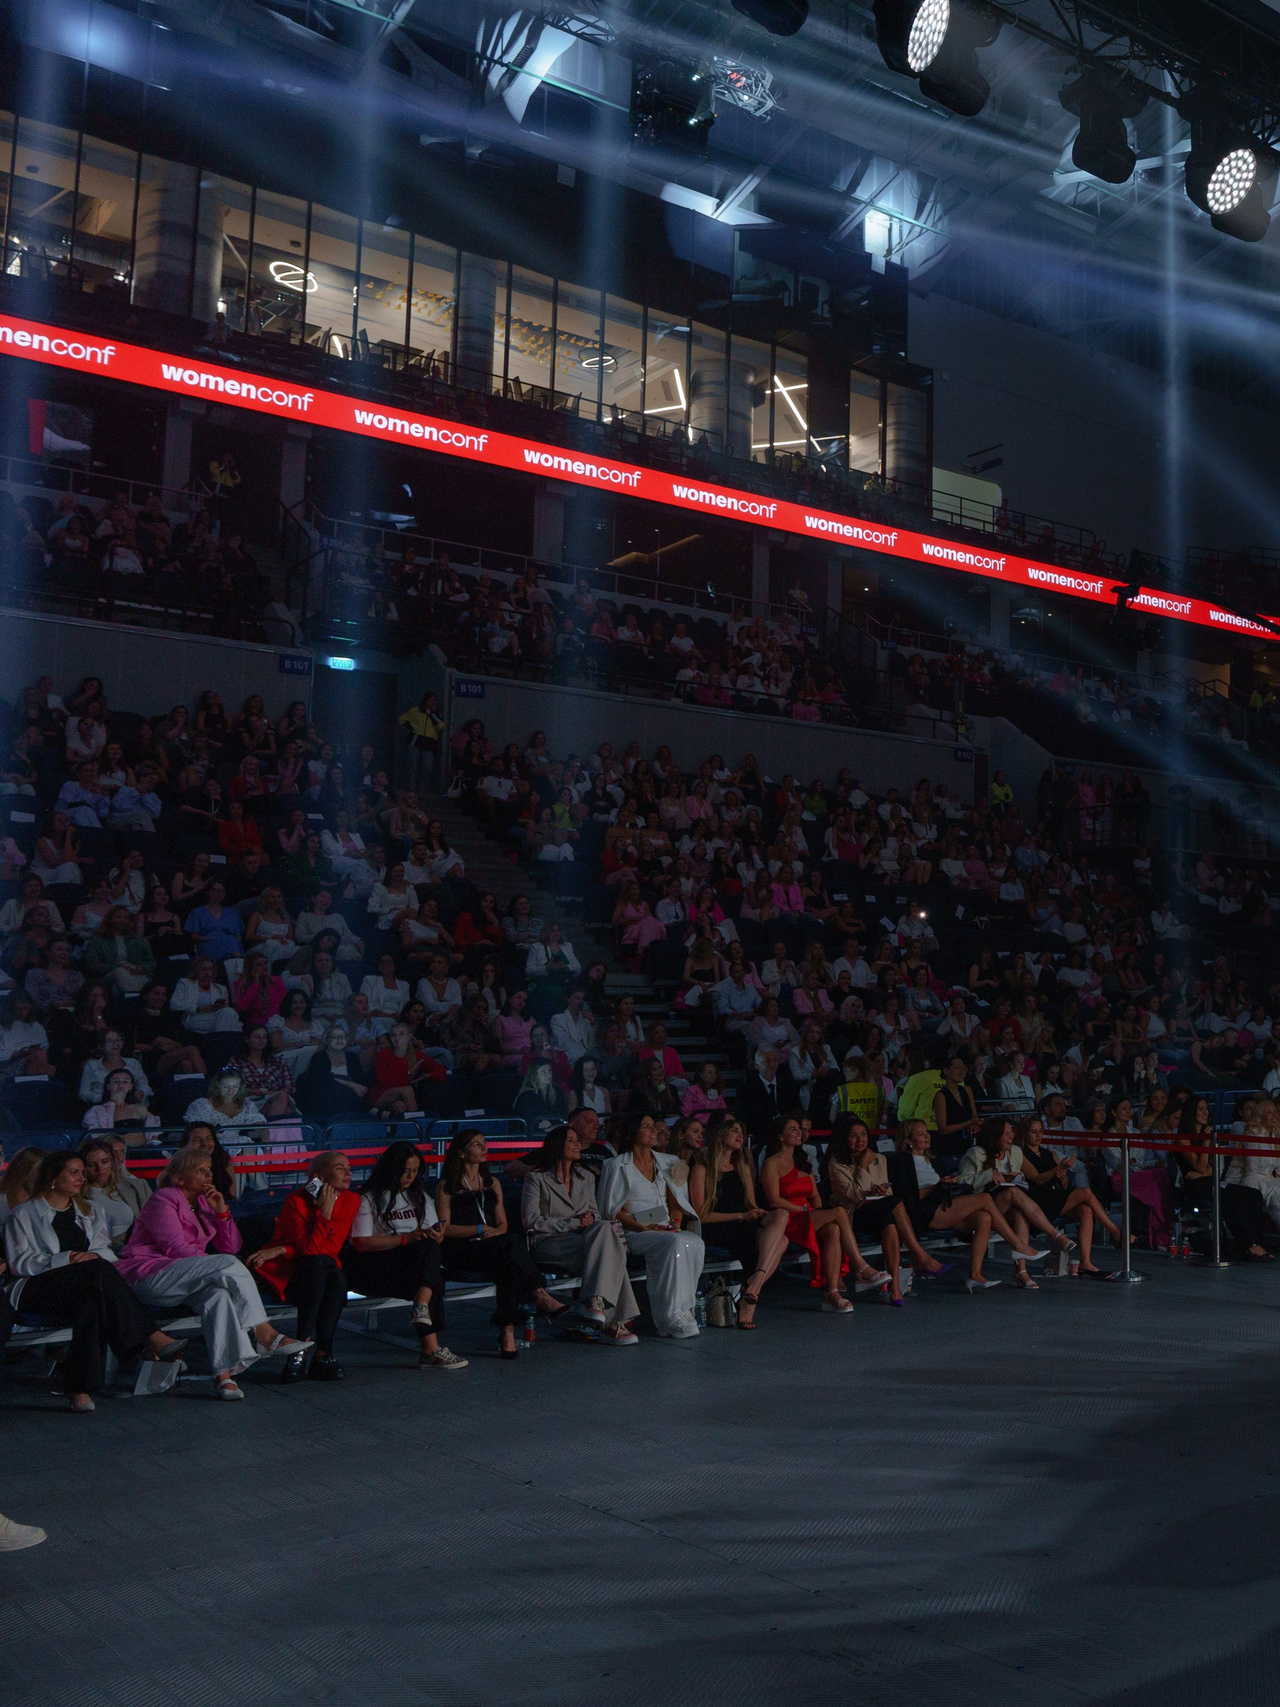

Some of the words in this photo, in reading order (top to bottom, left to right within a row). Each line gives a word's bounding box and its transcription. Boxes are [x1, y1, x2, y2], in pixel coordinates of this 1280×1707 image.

[160, 363, 315, 412] womenconf
[353, 408, 489, 452] womenconf
[523, 448, 642, 488] womenconf
[672, 483, 778, 519] womenconf
[804, 514, 898, 547] womenconf
[921, 542, 1007, 572] womenconf
[1027, 567, 1104, 595] womenconf
[1128, 593, 1192, 615] omenconf
[284, 660, 291, 668] B
[292, 661, 309, 671] 101
[460, 684, 467, 693] B
[468, 684, 482, 694] 101
[850, 1097, 876, 1105] SAFETY
